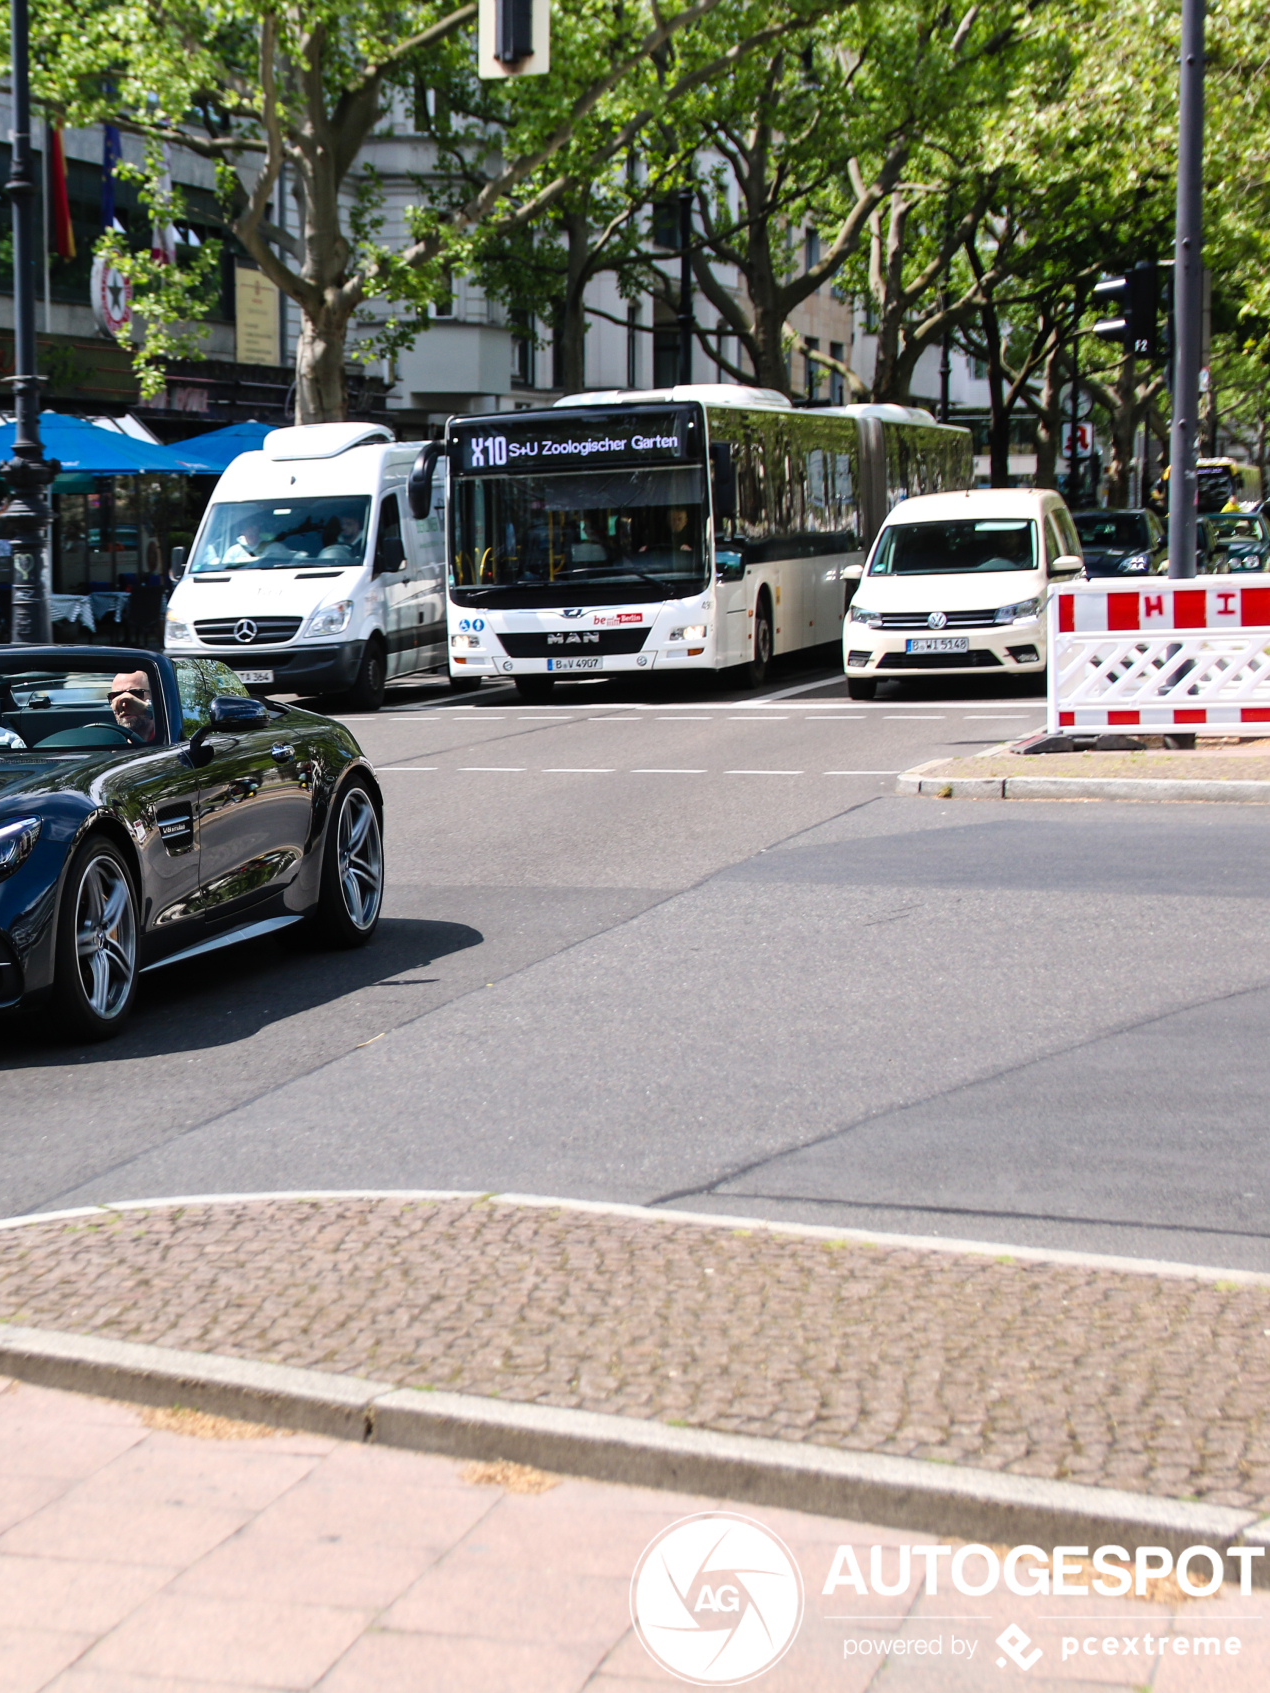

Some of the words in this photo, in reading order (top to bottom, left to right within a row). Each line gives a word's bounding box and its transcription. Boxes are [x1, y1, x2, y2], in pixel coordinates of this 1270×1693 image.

[471, 436, 507, 467] X10
[508, 442, 539, 457] S+U
[541, 438, 627, 456] Zoologischer
[631, 434, 678, 449] Garten
[547, 632, 600, 645] MAN
